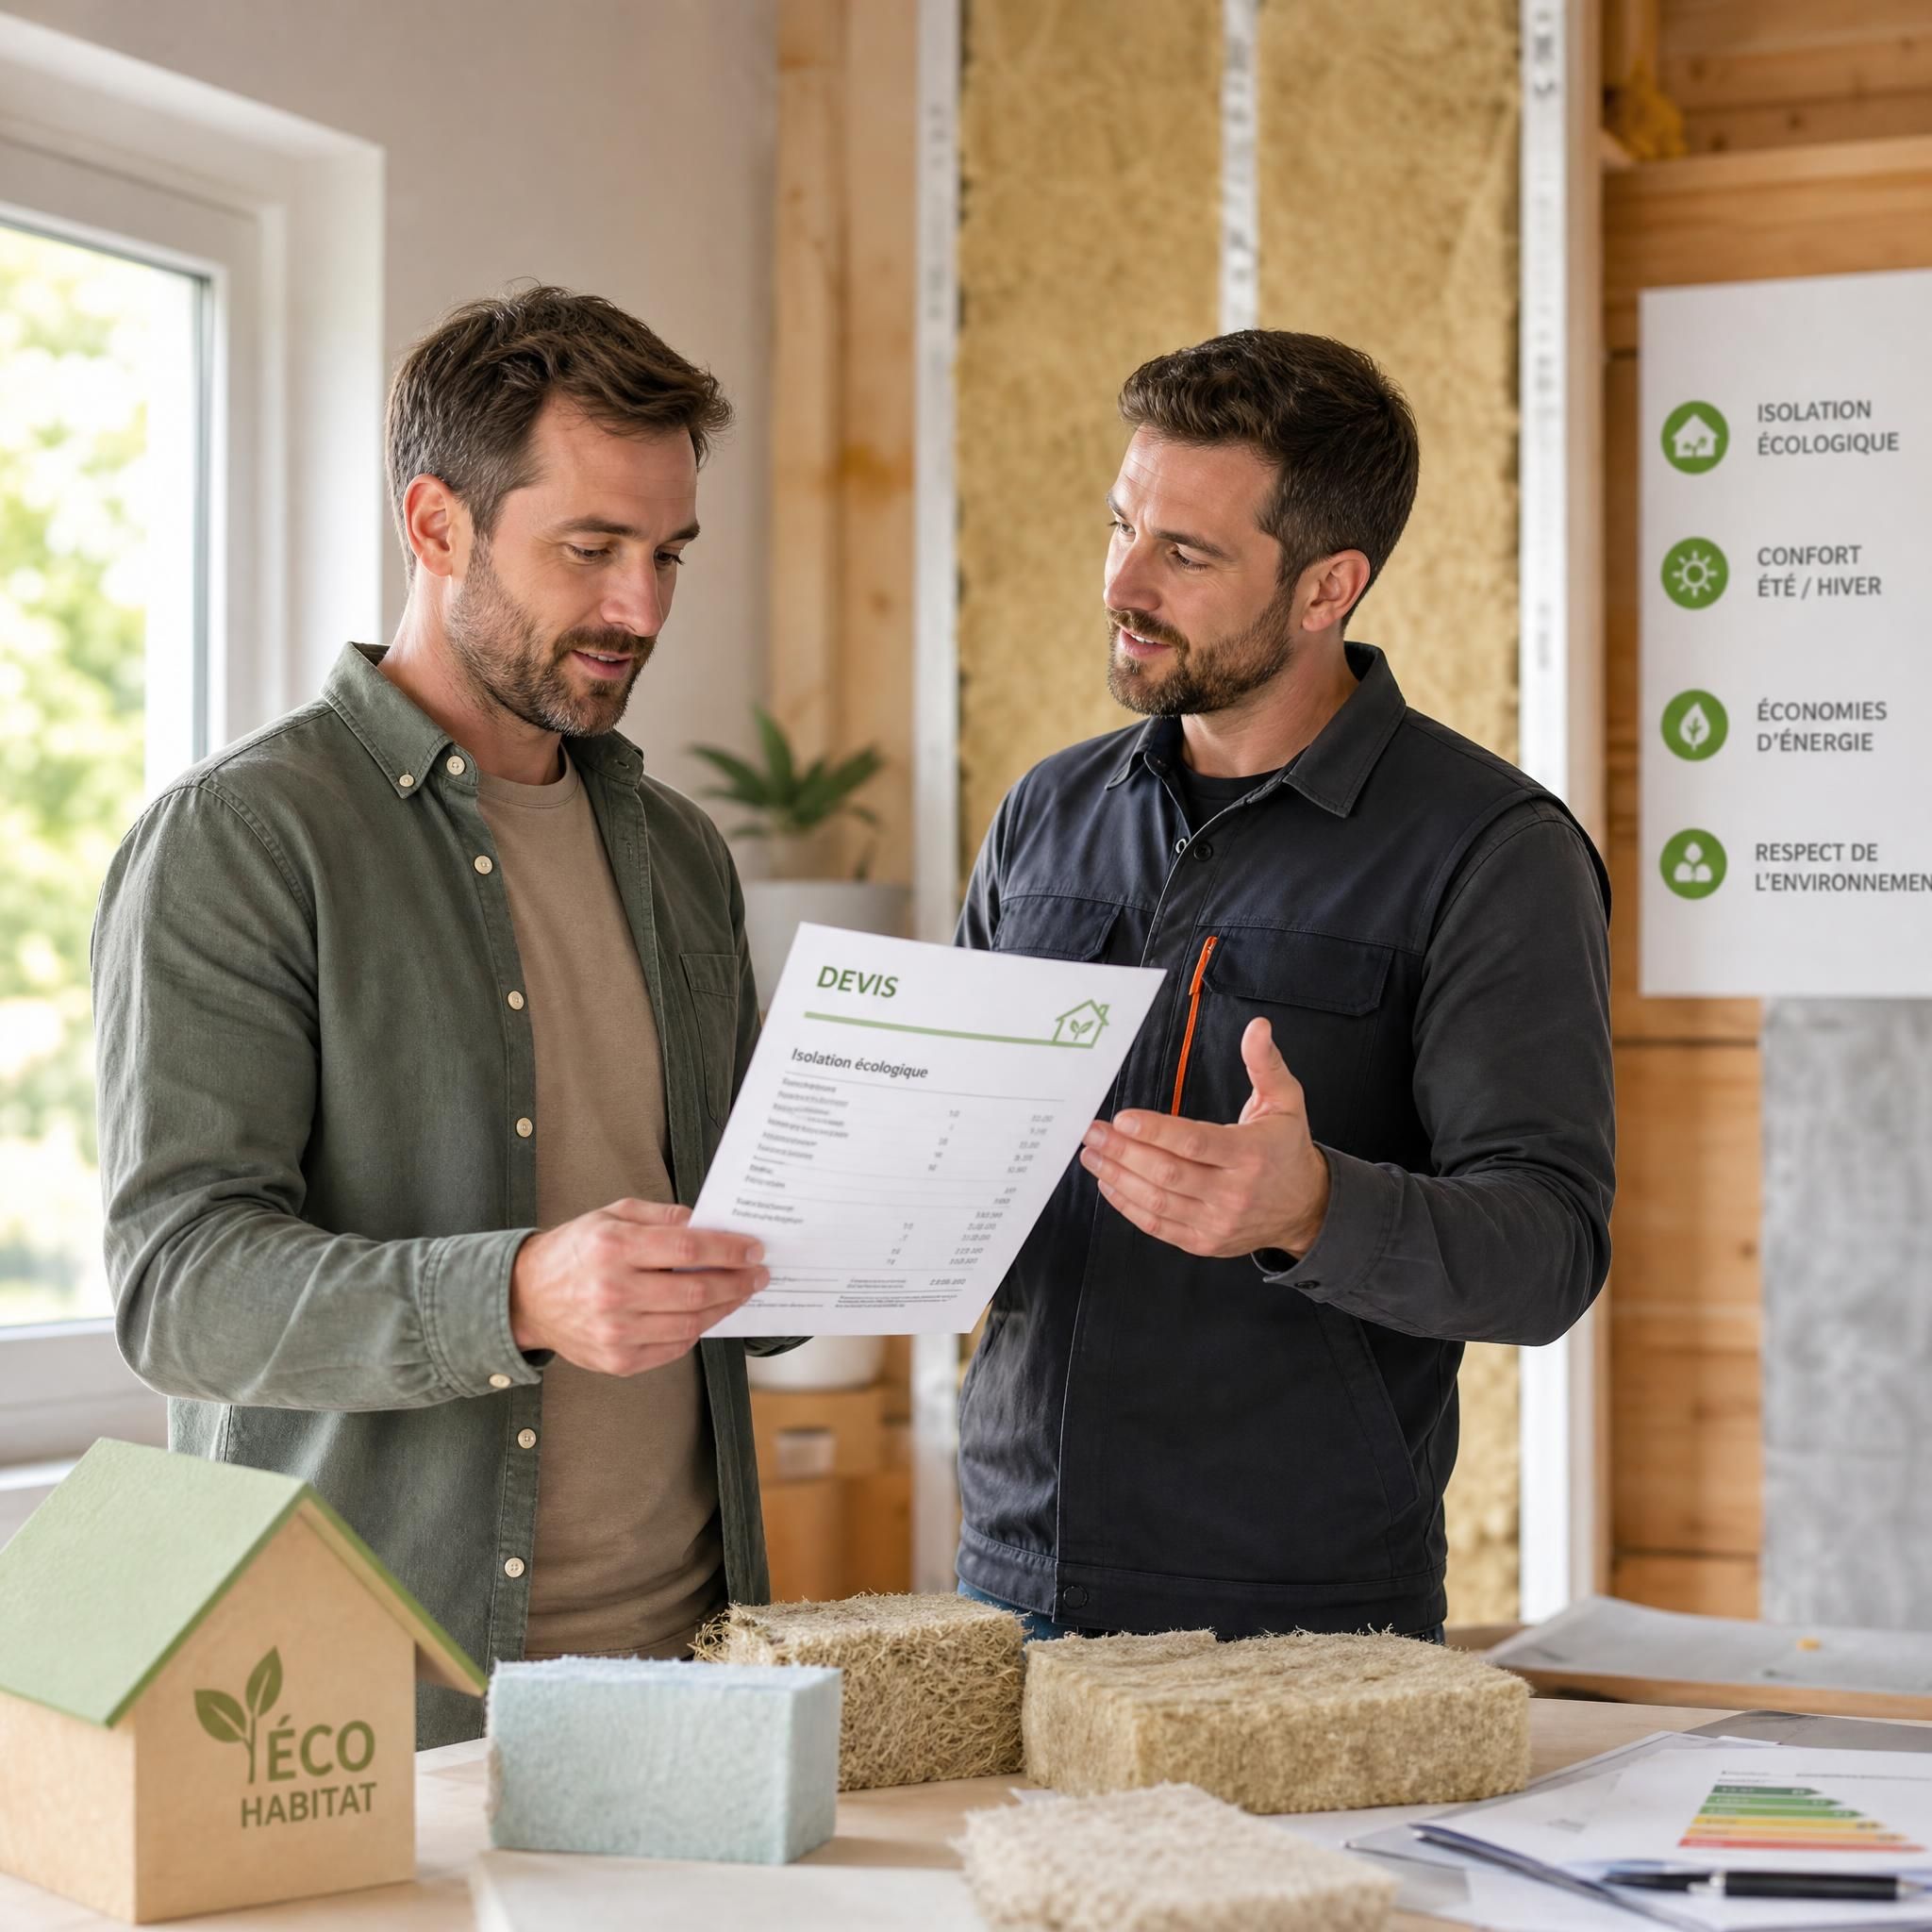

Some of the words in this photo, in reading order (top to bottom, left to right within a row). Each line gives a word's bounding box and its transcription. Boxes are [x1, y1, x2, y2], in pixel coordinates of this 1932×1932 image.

[1757, 400, 1872, 423] ISOLATION
[1757, 432, 1900, 456] ÉCOLOGIQUE
[1757, 545, 1862, 566] CONFORT
[1757, 574, 1796, 597] ÉTÉ
[1817, 576, 1881, 596] HIVER
[1757, 697, 1888, 722] ÉCONOMIES
[1757, 728, 1874, 752] D'ÉNERGIE
[1755, 843, 1844, 862] RESPECT
[1851, 843, 1878, 862] DE
[817, 965, 899, 998] DEVIS
[791, 1048, 852, 1069] Isolation
[855, 1058, 928, 1079] écologique
[267, 1713, 375, 1782] ÉCO
[241, 1782, 376, 1828] HABITAT
